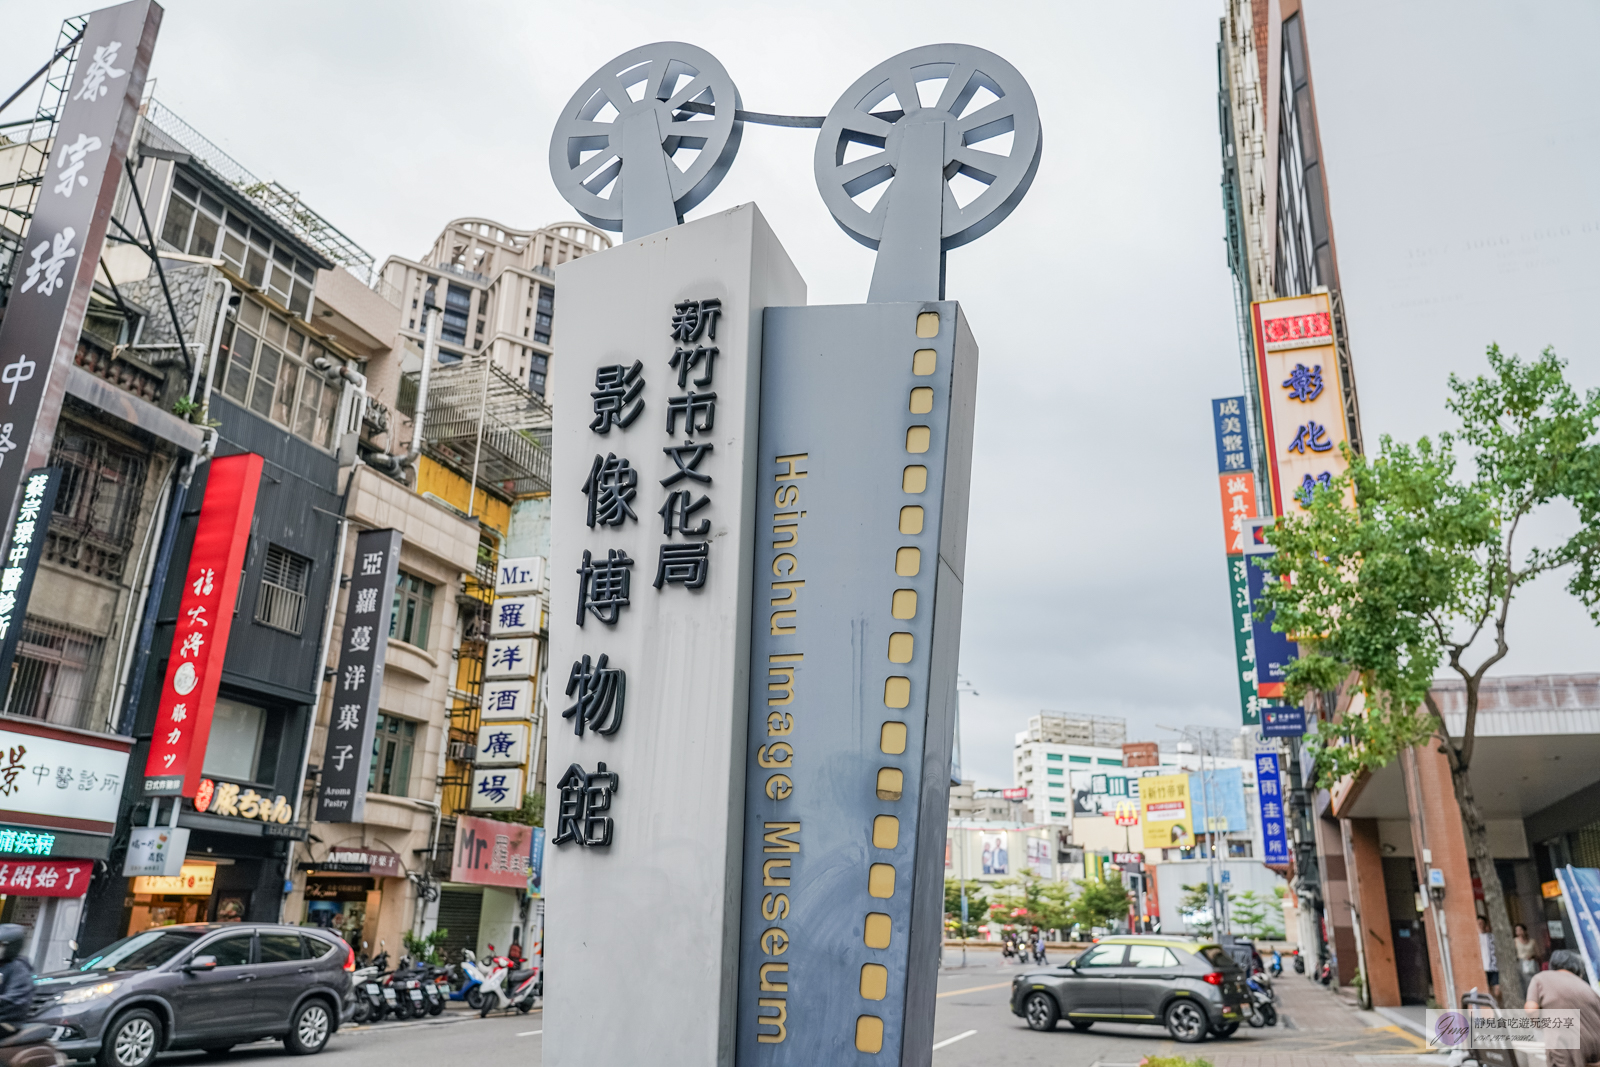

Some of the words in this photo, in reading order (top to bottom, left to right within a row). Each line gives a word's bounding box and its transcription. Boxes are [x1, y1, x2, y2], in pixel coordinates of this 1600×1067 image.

[651, 297, 722, 590] 新竹市文化局
[1219, 399, 1247, 469] 成美整型
[1282, 363, 1333, 550] 彰化銀
[500, 565, 534, 585] Mr.
[552, 359, 646, 849] 影像博物館
[768, 452, 809, 637] Hsinchu
[331, 550, 384, 772] 亞蘿蔓洋菓子
[478, 602, 526, 803] 羅洋酒廣場
[32, 763, 121, 796] 中醫診所
[757, 653, 804, 802] Image
[323, 798, 348, 810] Pastry
[324, 787, 351, 796] Aroma
[457, 827, 489, 870] Mr.
[1258, 756, 1283, 853] 吳雨圭診所
[1115, 853, 1140, 863] KFC
[755, 820, 802, 1045] Museum
